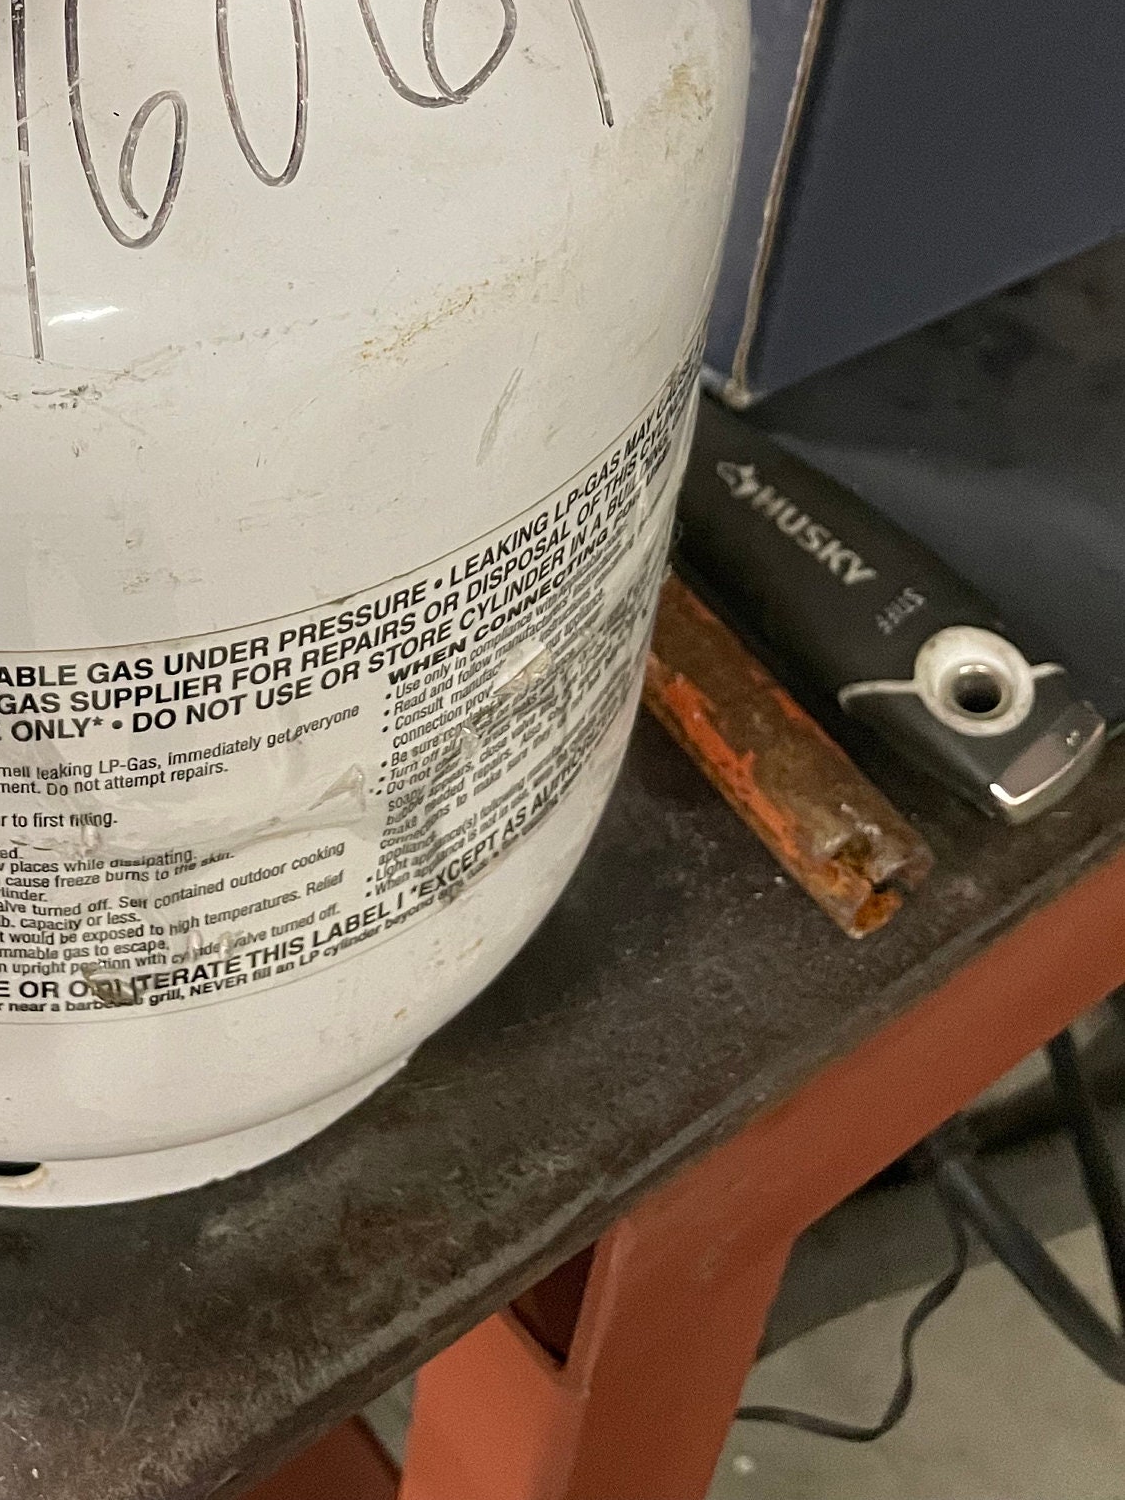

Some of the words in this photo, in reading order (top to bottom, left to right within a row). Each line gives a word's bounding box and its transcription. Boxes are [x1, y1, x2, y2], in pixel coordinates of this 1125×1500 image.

[86, 657, 154, 684] GAS
[164, 636, 269, 675] UNDER
[279, 579, 428, 651] PRESSURE
[450, 512, 549, 587] LEAKING
[554, 449, 621, 523] LP-GAS
[624, 409, 655, 458] MAY
[753, 486, 877, 587] HUSKY
[70, 674, 222, 712] SUPPLIER
[232, 657, 292, 690] FOR
[301, 612, 416, 672] REPAIRS
[424, 592, 459, 623] OR
[466, 520, 571, 604] DISPOSAL
[577, 491, 604, 526] OF
[603, 453, 637, 503] THIS
[388, 636, 466, 685] WHEN
[474, 527, 608, 642] CONNECTING
[132, 708, 176, 733] DO
[186, 693, 248, 725] NOT
[255, 676, 313, 710] USE
[320, 660, 360, 690] OR
[368, 619, 453, 673] STORE
[459, 547, 564, 630] CYLINDER
[569, 524, 587, 558] IN
[590, 512, 602, 538] A
[394, 687, 427, 715] Read
[430, 676, 453, 698] and
[394, 695, 444, 730] Consult
[396, 680, 420, 699] Use
[424, 662, 451, 685] only
[36, 762, 92, 781] leaking
[99, 757, 161, 775] LP-Gas,
[168, 735, 261, 767] immediately
[267, 729, 290, 748] get
[295, 705, 360, 738] everyone
[393, 704, 463, 748] connection
[47, 783, 68, 796] Do
[74, 777, 101, 794] not
[105, 770, 166, 790] attempt
[170, 762, 228, 782] repairs.
[12, 813, 28, 828] to
[33, 813, 64, 827] first
[6, 876, 50, 888] cause
[55, 873, 100, 888] freeze
[105, 871, 149, 882] burns
[155, 868, 169, 881] to
[10, 860, 59, 874] places
[64, 858, 104, 872] while
[33, 902, 81, 916] turned
[154, 877, 224, 909] contained
[230, 861, 287, 888] outdoor
[292, 842, 345, 870] cooking
[19, 980, 59, 999] OR
[246, 936, 305, 968] THIS
[312, 901, 391, 947] LABEL
[502, 806, 527, 841] AS
[20, 917, 82, 932] capacity
[86, 915, 103, 927] or
[107, 911, 142, 925] less.
[82, 923, 144, 944] exposed
[150, 922, 164, 936] to
[169, 916, 200, 936] high
[204, 889, 302, 925] temperatures.
[306, 868, 345, 896] Relief
[12, 961, 65, 976] upright
[135, 951, 166, 967] with
[271, 910, 315, 936] turned
[63, 946, 90, 961] gas
[189, 973, 247, 997] NEVER
[323, 923, 382, 957] cylinder
